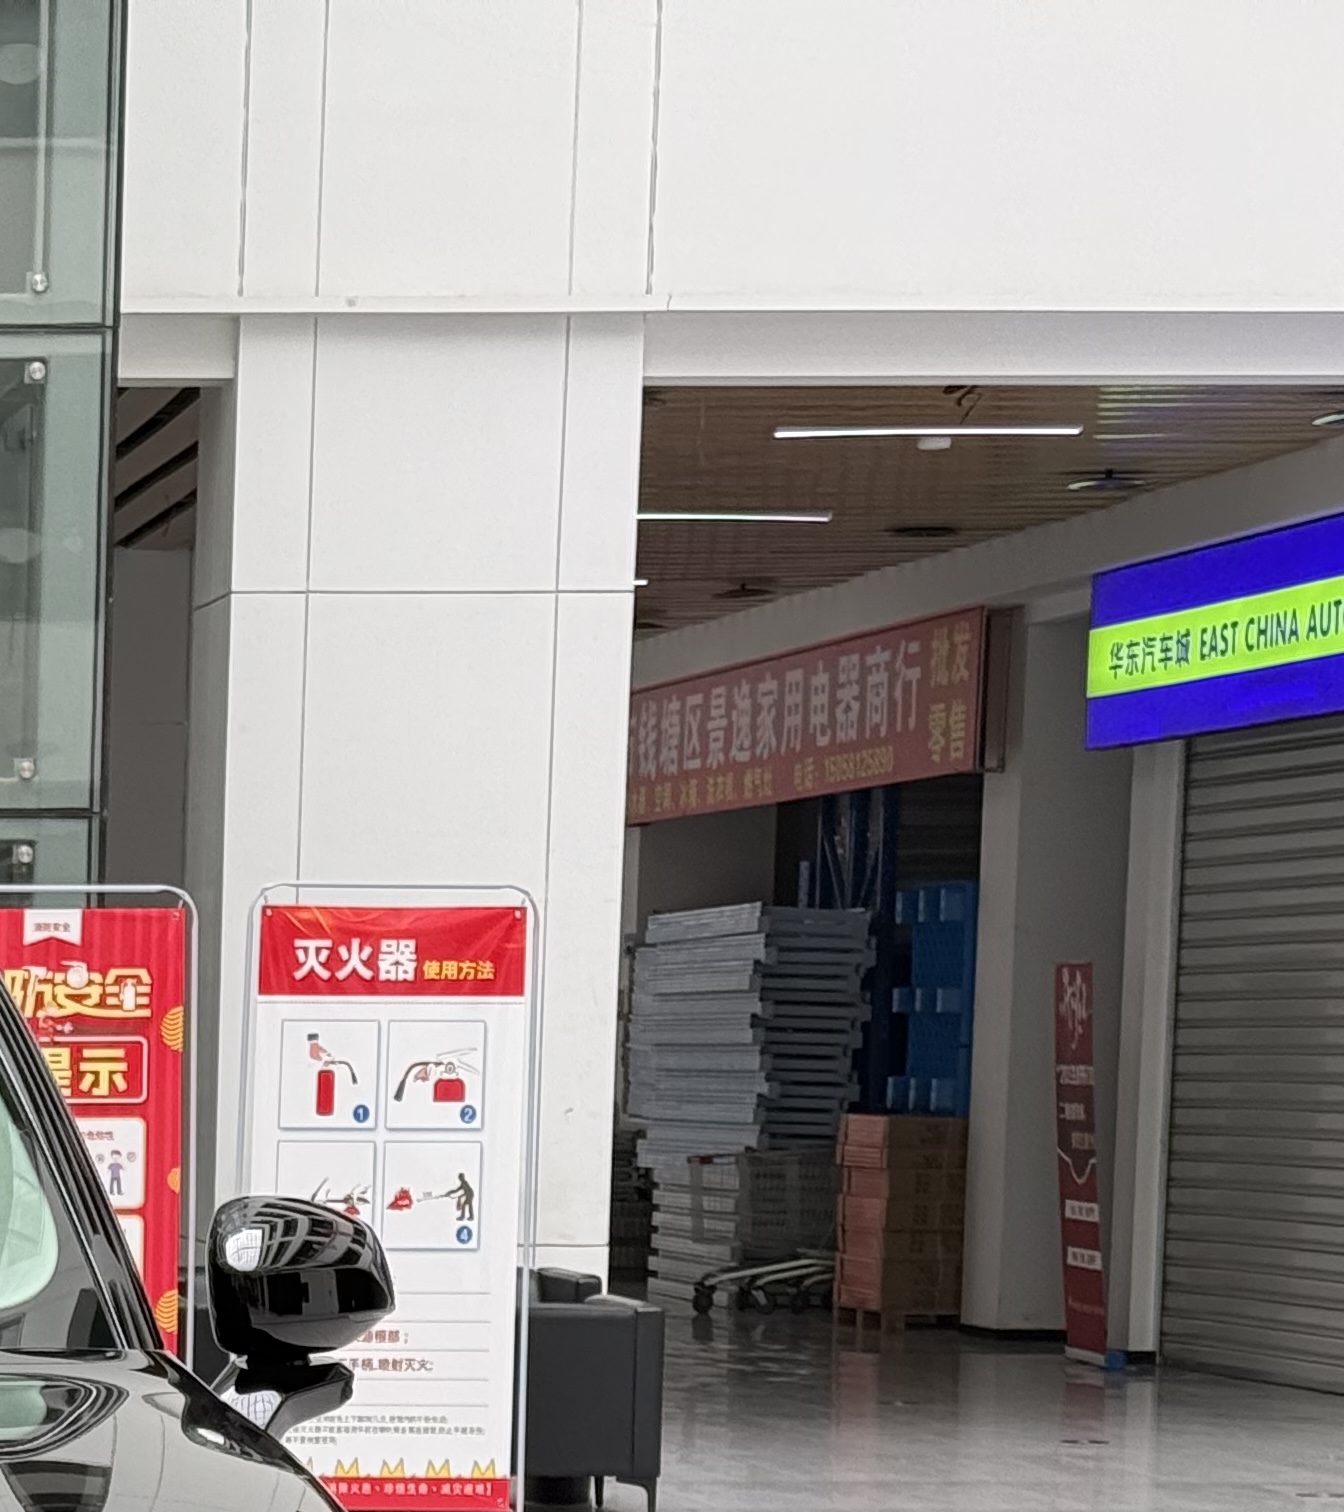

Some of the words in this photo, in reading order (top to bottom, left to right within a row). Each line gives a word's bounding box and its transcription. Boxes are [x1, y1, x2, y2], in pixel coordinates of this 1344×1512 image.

[929, 620, 971, 689] 批发
[1108, 627, 1191, 680] 华东汽车城
[1199, 620, 1239, 662] EAST
[1245, 608, 1300, 652] CHINA
[1306, 599, 1344, 641] AUT
[630, 639, 922, 781] 钱塘区景逸家用电器商行
[928, 701, 968, 764] 零售
[292, 937, 418, 981] 灭火器
[422, 960, 496, 981] 使用方法
[356, 1329, 409, 1345] 根部；
